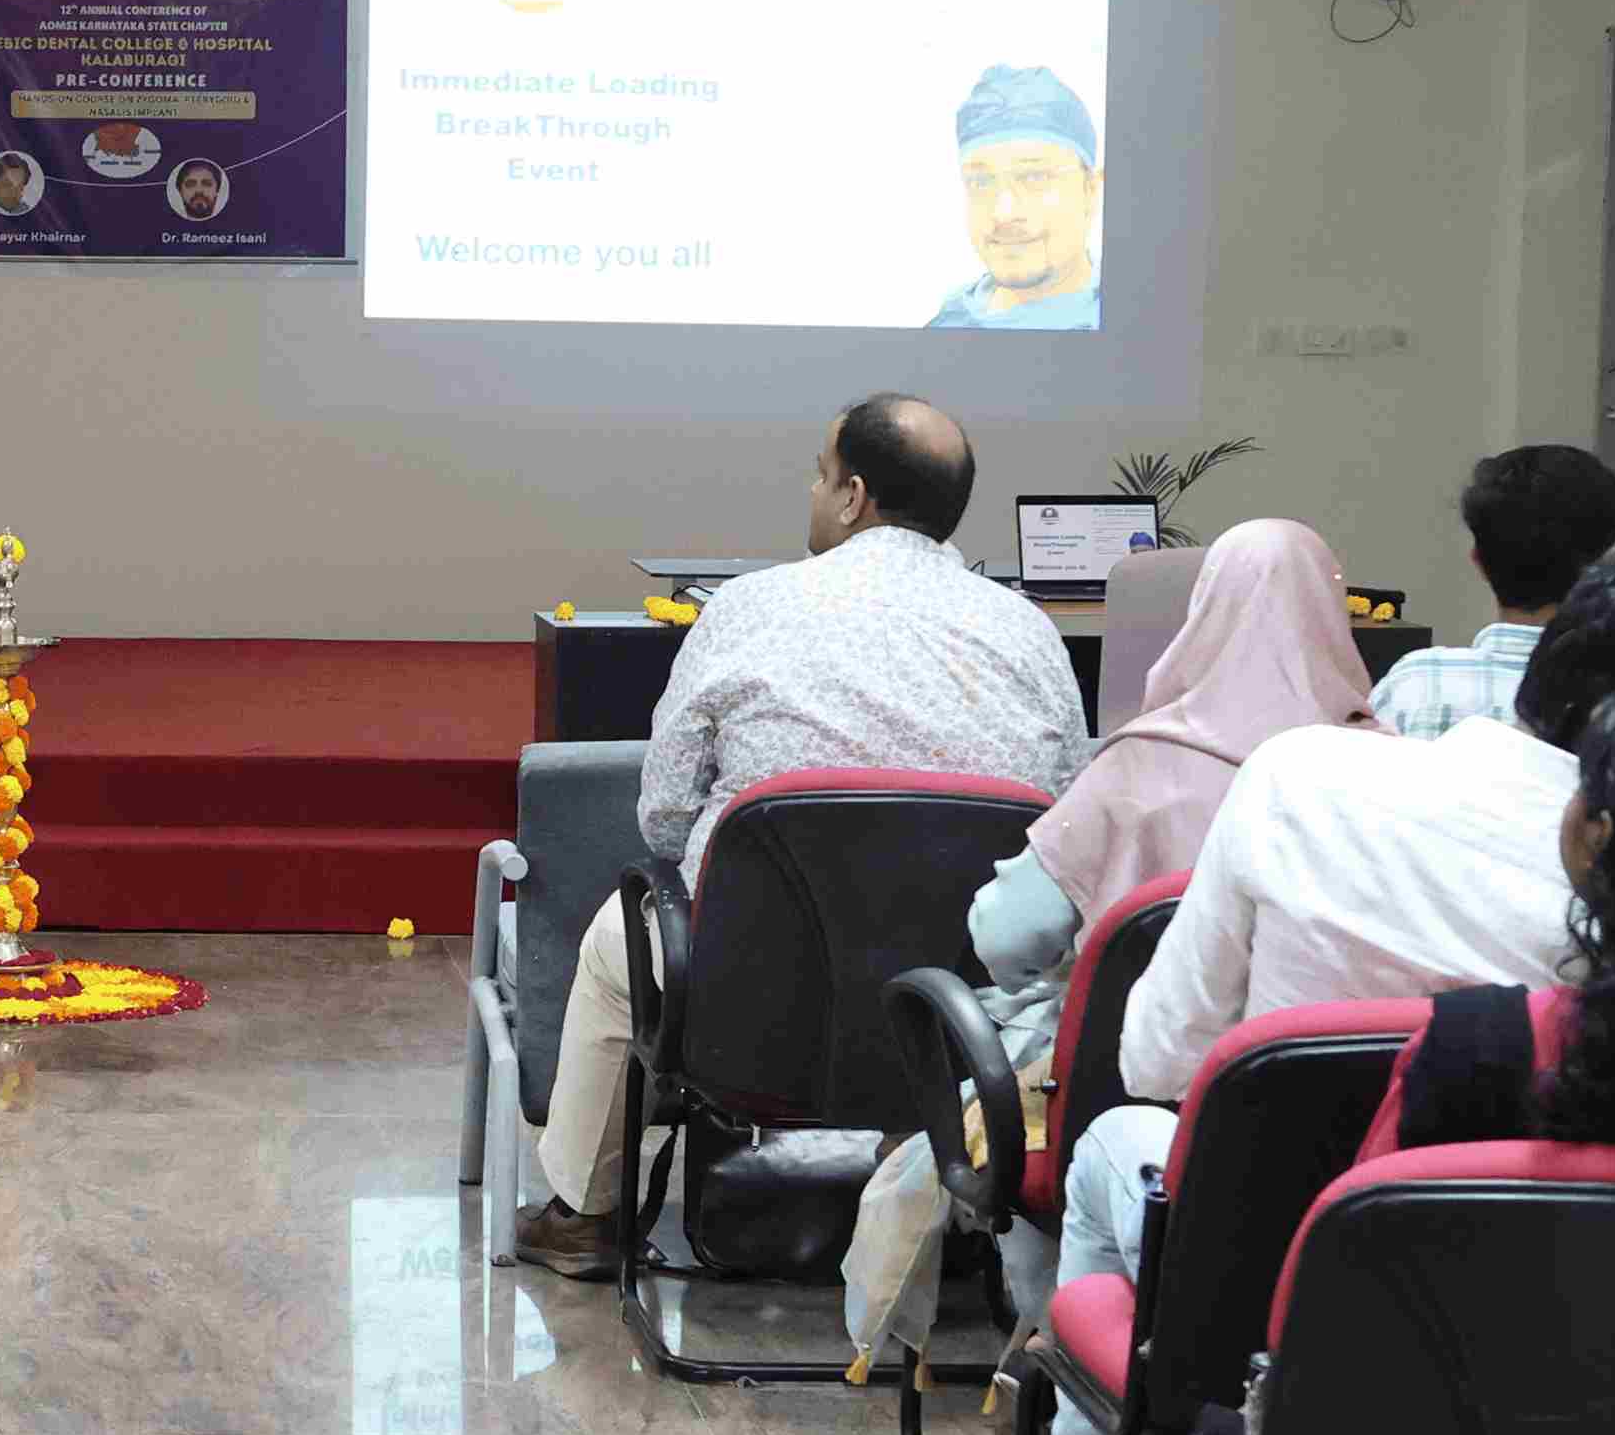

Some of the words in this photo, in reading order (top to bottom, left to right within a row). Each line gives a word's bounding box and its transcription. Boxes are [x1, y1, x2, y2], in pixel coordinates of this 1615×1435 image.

[79, 5, 122, 15] ANNUAL
[125, 6, 191, 16] CONFERENCE
[193, 6, 208, 15] OF
[80, 21, 145, 31] KARNATAKA
[147, 22, 178, 32] STATE
[180, 22, 227, 32] CHAPTER
[37, 37, 97, 50] DENTAL
[102, 38, 173, 51] COLLEGE
[193, 38, 273, 51] HOSPITAL
[81, 54, 187, 66] KALABURAGI
[56, 74, 207, 87] PRE-CONFERENCE
[399, 68, 576, 94] Immediate
[589, 69, 719, 102] Loading
[435, 112, 673, 145] BreakThrough
[507, 158, 600, 182] Event
[31, 231, 88, 243] Khairnar
[162, 232, 180, 243] Dr.
[414, 234, 582, 266] Welcome
[595, 244, 659, 272] you
[672, 241, 713, 268] all
